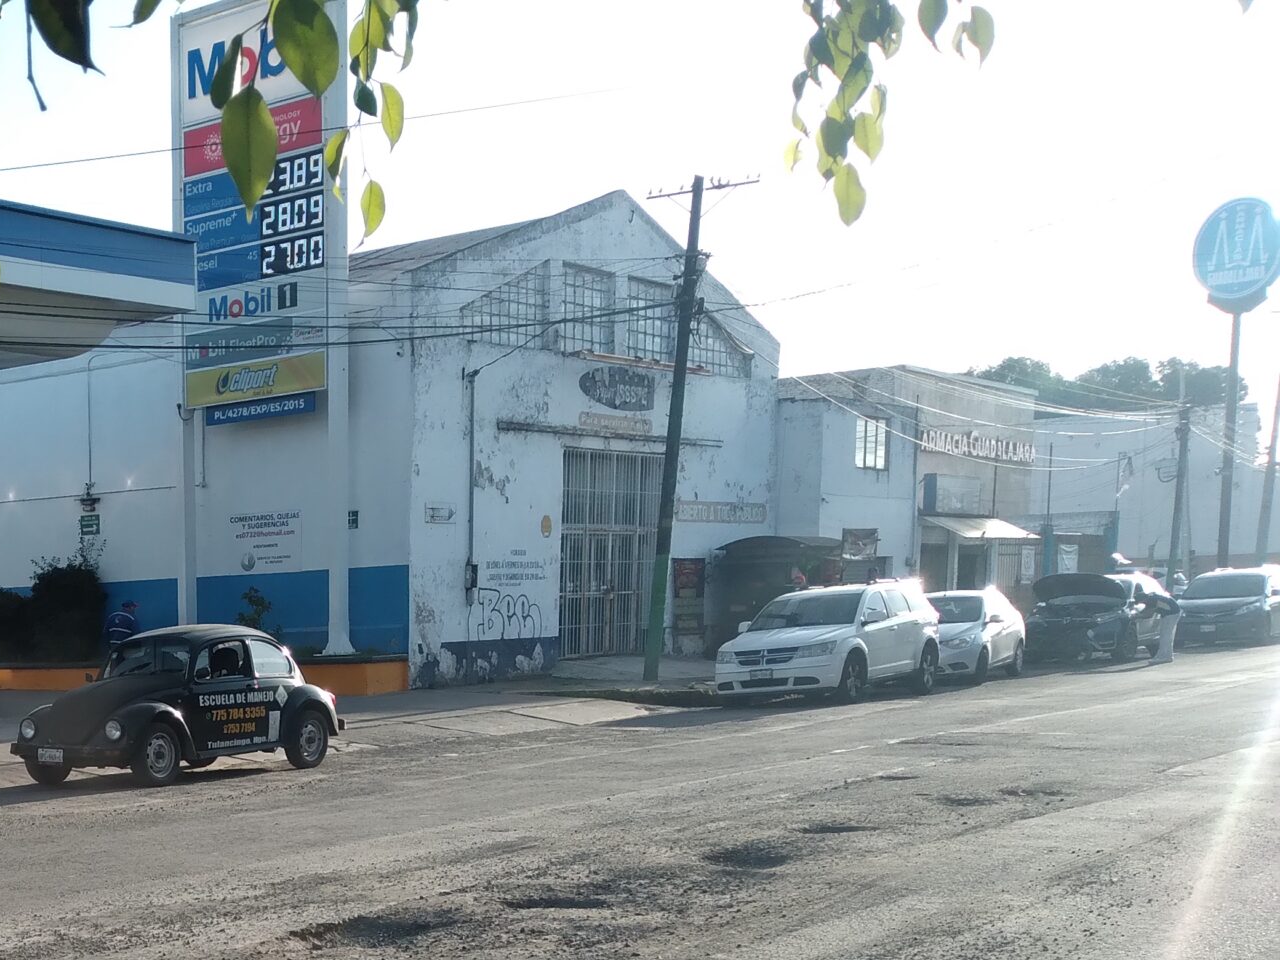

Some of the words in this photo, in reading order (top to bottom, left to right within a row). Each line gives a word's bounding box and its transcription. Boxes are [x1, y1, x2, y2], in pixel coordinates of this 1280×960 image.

[187, 27, 287, 100] Mob
[273, 110, 301, 122] NOLOGY
[185, 180, 213, 197] Extra
[262, 194, 323, 235] 28.09
[198, 256, 218, 272] esel
[208, 286, 272, 322] Mobil
[187, 339, 226, 361] Mobil
[214, 399, 305, 420] PL/4278/EXP/ES/2015
[921, 429, 968, 456] ARMACIA
[229, 513, 275, 524] COMENTARIOS,
[276, 511, 300, 521] QUEJAS
[247, 520, 290, 530] SUGERENCIAS
[199, 693, 235, 707] ESCUELA
[236, 692, 246, 704] DE
[247, 690, 274, 703] MANEJO
[211, 709, 227, 721] 775
[228, 708, 244, 720] 784
[245, 706, 266, 719] 3355
[227, 723, 240, 733] 753
[240, 722, 255, 733] 7194
